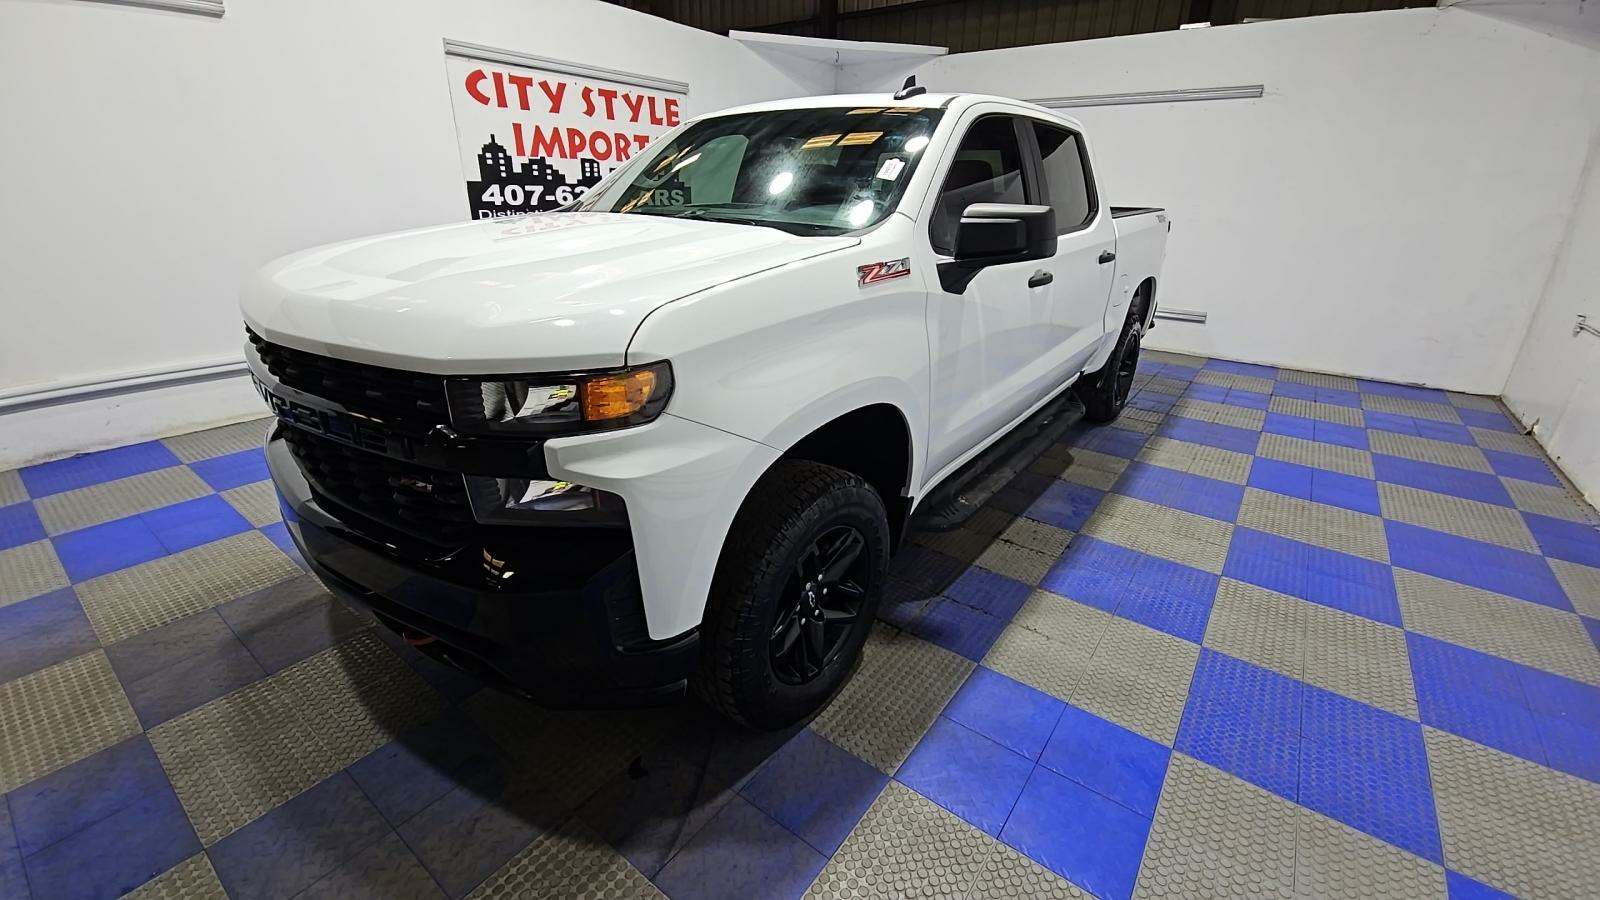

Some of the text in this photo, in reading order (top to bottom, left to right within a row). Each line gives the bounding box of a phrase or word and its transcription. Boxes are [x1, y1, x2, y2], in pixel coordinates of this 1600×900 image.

[465, 69, 681, 127] CITY STYLE
[512, 122, 650, 162] IMPORT
